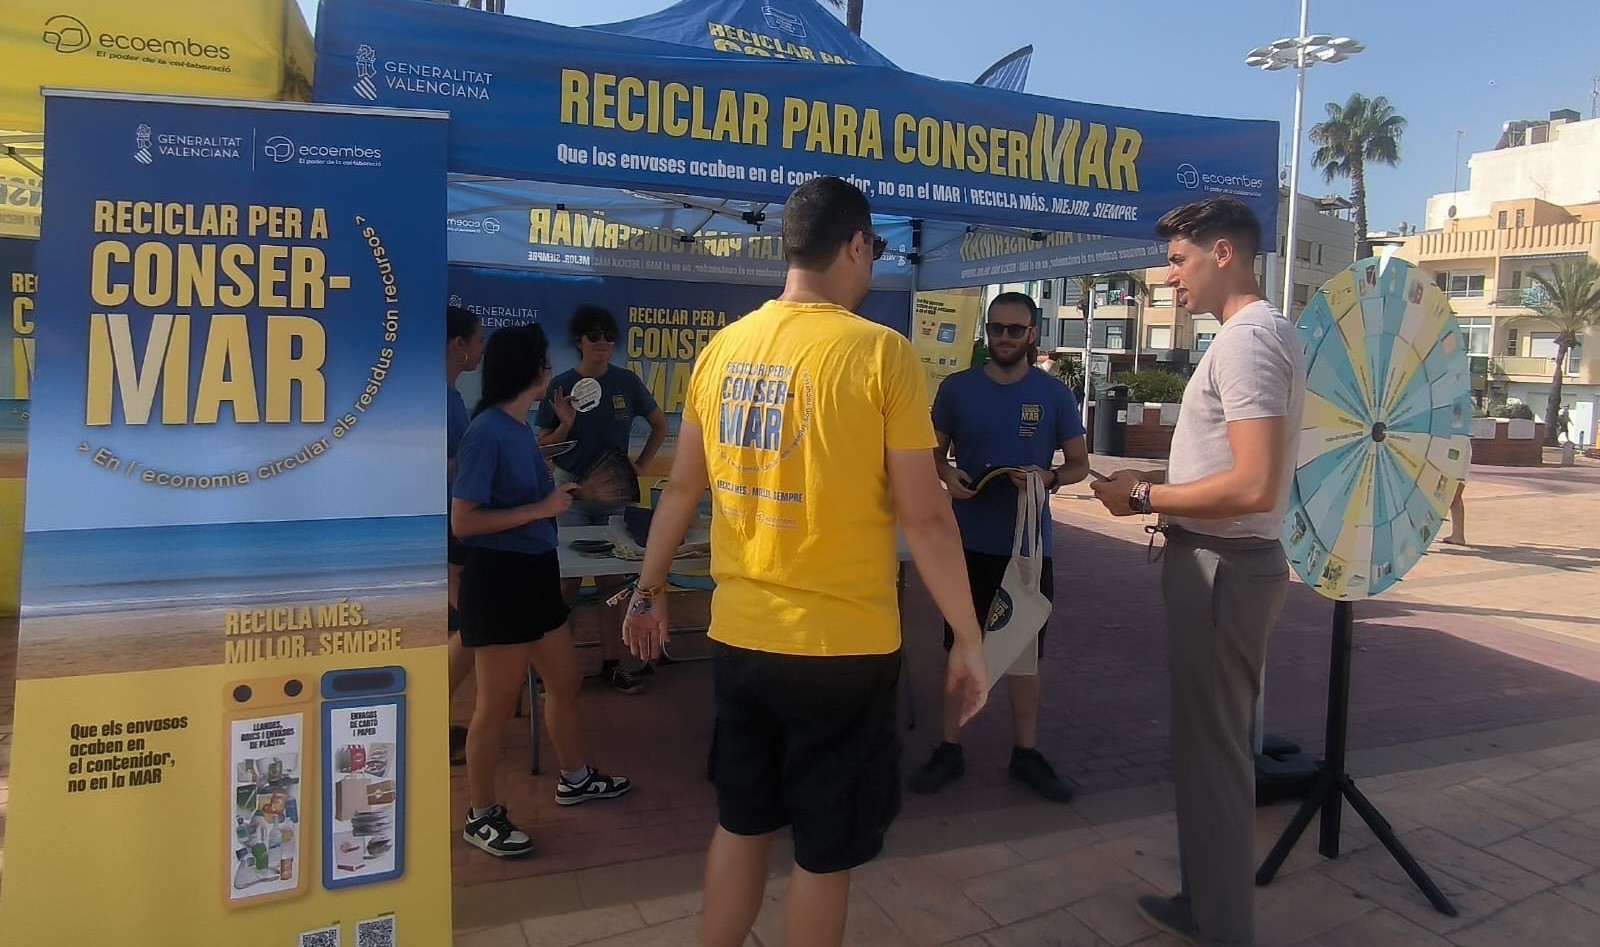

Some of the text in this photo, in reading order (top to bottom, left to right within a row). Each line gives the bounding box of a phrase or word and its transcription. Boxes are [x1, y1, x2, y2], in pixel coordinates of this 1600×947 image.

[99, 33, 231, 60] ecoembes
[708, 21, 816, 61] RECICLAR
[109, 53, 139, 61] poder
[385, 61, 493, 84] GENERALITAT
[386, 75, 490, 100] VALENCIANA
[158, 134, 243, 148] GENERALITAT
[560, 68, 1143, 191] RECICLAR PARA CONSERMAR
[158, 146, 241, 159] VALENCIANA
[299, 145, 382, 159] ecoembes
[557, 143, 588, 164] Que
[592, 146, 616, 168] los
[621, 153, 686, 174] envases
[690, 159, 745, 180] acaben
[749, 167, 766, 182] en
[771, 166, 783, 184] el
[879, 181, 895, 196] no
[898, 183, 914, 198] en
[918, 182, 930, 200] el
[933, 184, 960, 203] MAR
[970, 188, 1018, 209] RECICLA
[1019, 193, 1048, 212] MÁS.
[1051, 197, 1090, 217] MEJOR.
[1092, 202, 1138, 221] SIEMPRE
[1202, 173, 1263, 189] ecoembes
[94, 200, 329, 240] RECICLAR PER A
[91, 240, 351, 309] CONSER-
[363, 226, 399, 303] recursos
[467, 304, 539, 318] GENERALITAT
[629, 306, 726, 326] RECICLAR PER A
[382, 309, 399, 342] són
[627, 326, 720, 360] CONSE
[86, 313, 326, 426] MAR
[355, 347, 394, 413] residus
[333, 412, 358, 439] els
[720, 402, 783, 451] MAR
[93, 447, 121, 472] En
[256, 437, 331, 480] circular
[773, 490, 803, 502] SEMPRE
[224, 599, 370, 636] RECICLA MÉS.
[224, 627, 402, 665] MILLOR. SEMPRE
[70, 716, 188, 741] Que els envasos
[351, 711, 377, 720] ENVASOS
[70, 738, 145, 757] acaben en
[69, 752, 176, 774] el contenidor,
[68, 768, 161, 793] no en la MAR
